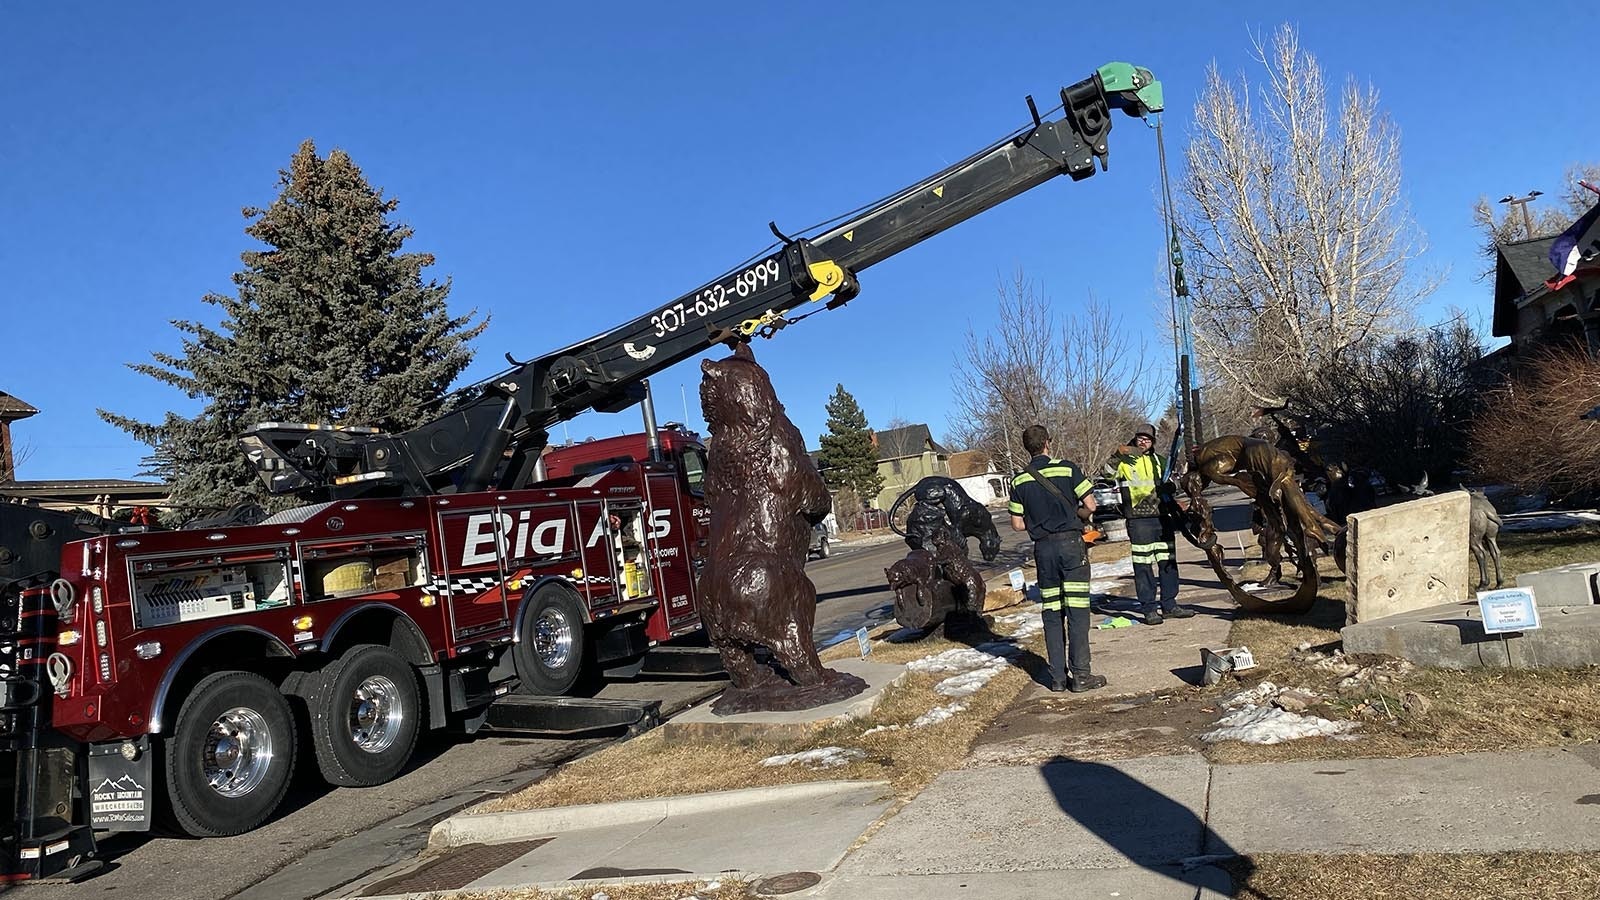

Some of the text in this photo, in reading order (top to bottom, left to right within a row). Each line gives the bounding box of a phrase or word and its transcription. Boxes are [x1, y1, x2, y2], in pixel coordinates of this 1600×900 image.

[651, 259, 780, 338] 307-632-6999
[461, 510, 567, 567] Big
[94, 791, 142, 801] ROCKY MOUNTAIN
